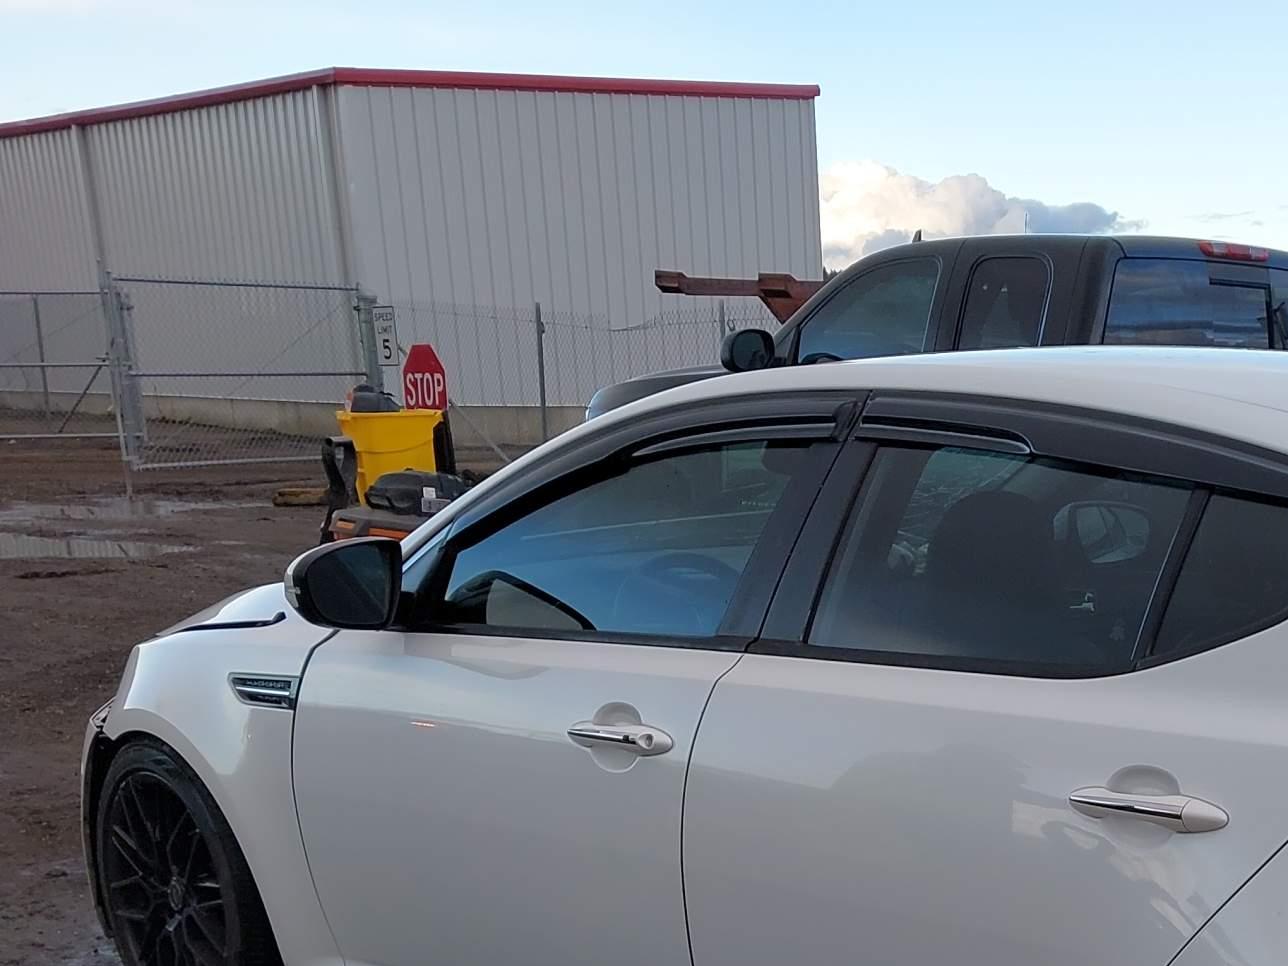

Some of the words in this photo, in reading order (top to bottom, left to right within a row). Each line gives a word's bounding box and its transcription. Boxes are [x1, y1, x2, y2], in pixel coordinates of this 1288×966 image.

[374, 312, 393, 322] SPEED
[377, 325, 392, 335] LIMIT
[382, 338, 392, 360] 5
[406, 372, 444, 406] STOP
